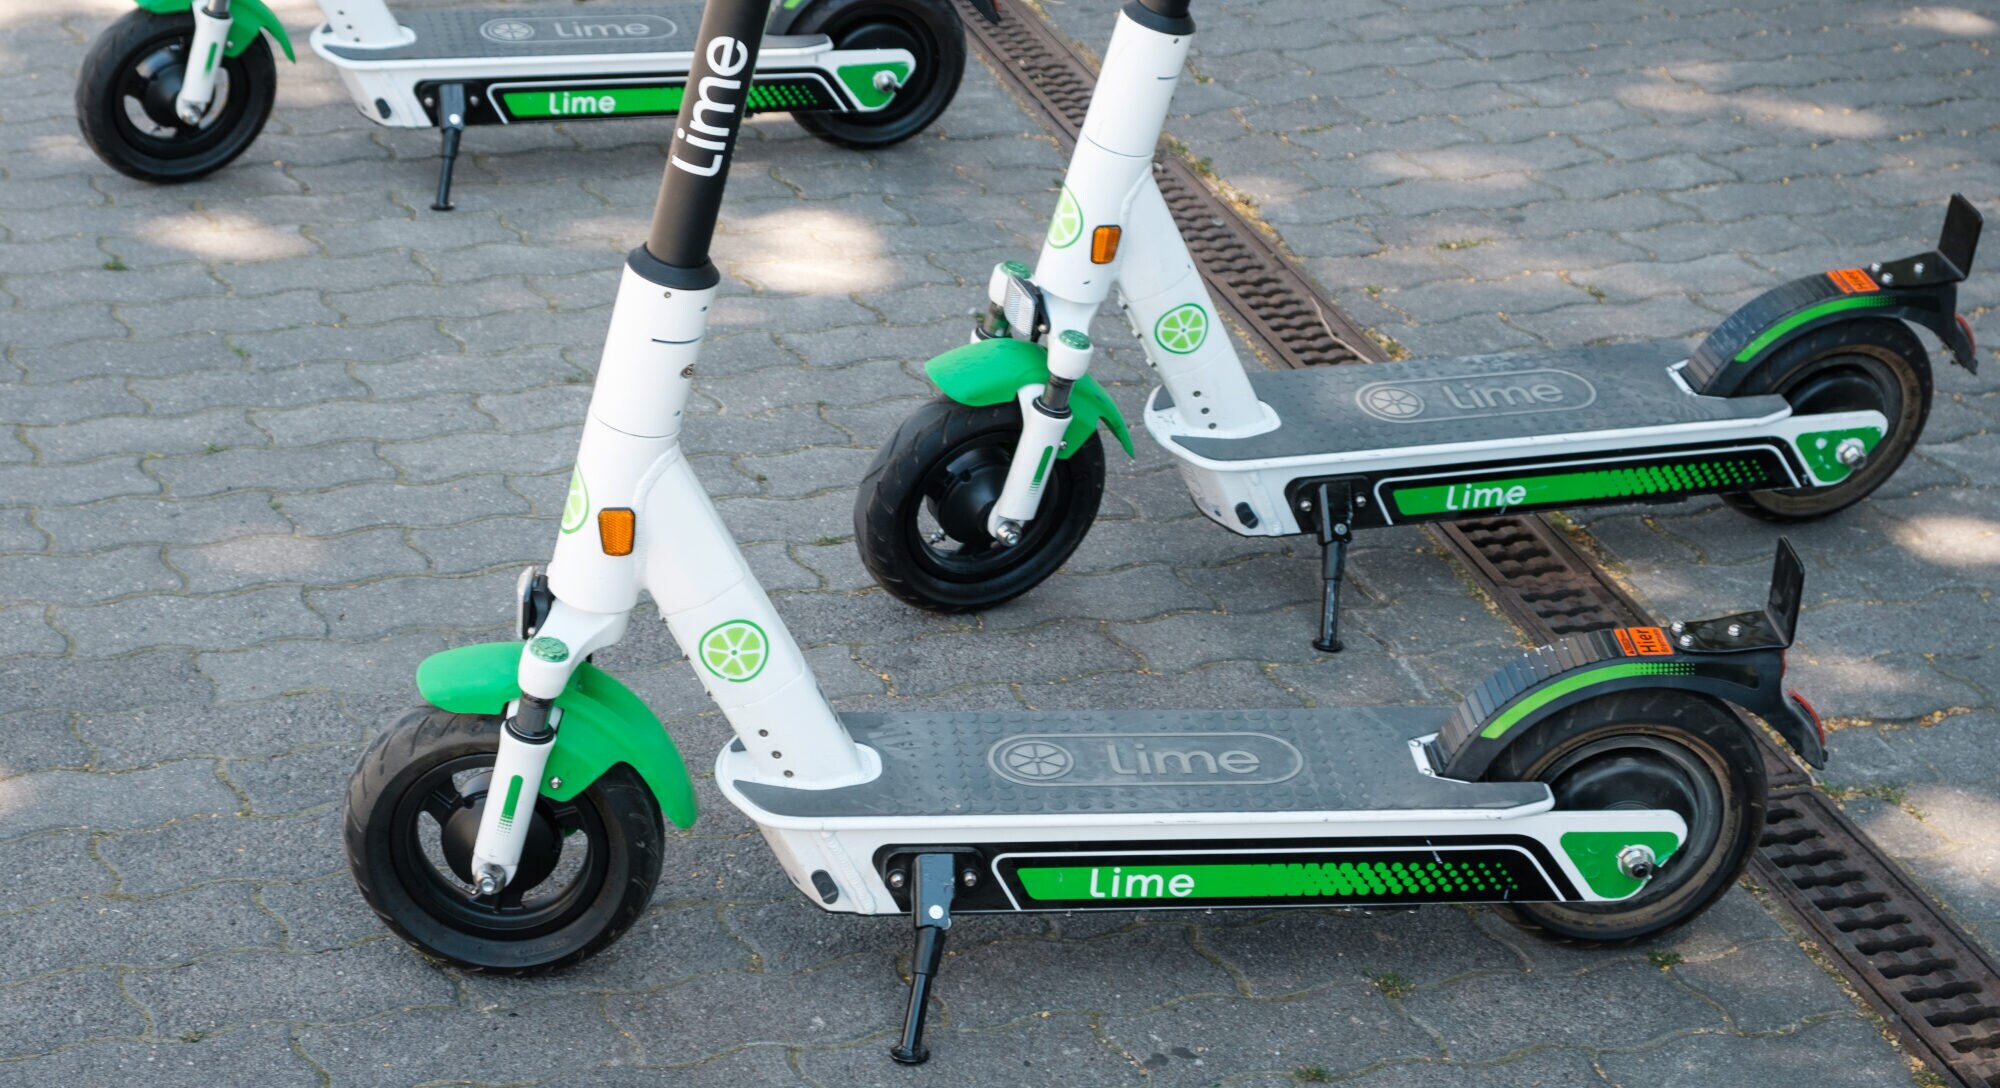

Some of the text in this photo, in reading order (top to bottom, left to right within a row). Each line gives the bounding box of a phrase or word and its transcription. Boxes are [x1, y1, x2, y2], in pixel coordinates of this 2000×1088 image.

[554, 21, 650, 37] Lime
[549, 91, 616, 115] Lime
[671, 35, 749, 178] Lime
[1442, 384, 1565, 410] Lime
[1445, 483, 1528, 511] Lime
[1636, 629, 1660, 653] Hier
[1106, 743, 1261, 776] Lime
[1089, 867, 1196, 898] Lime
